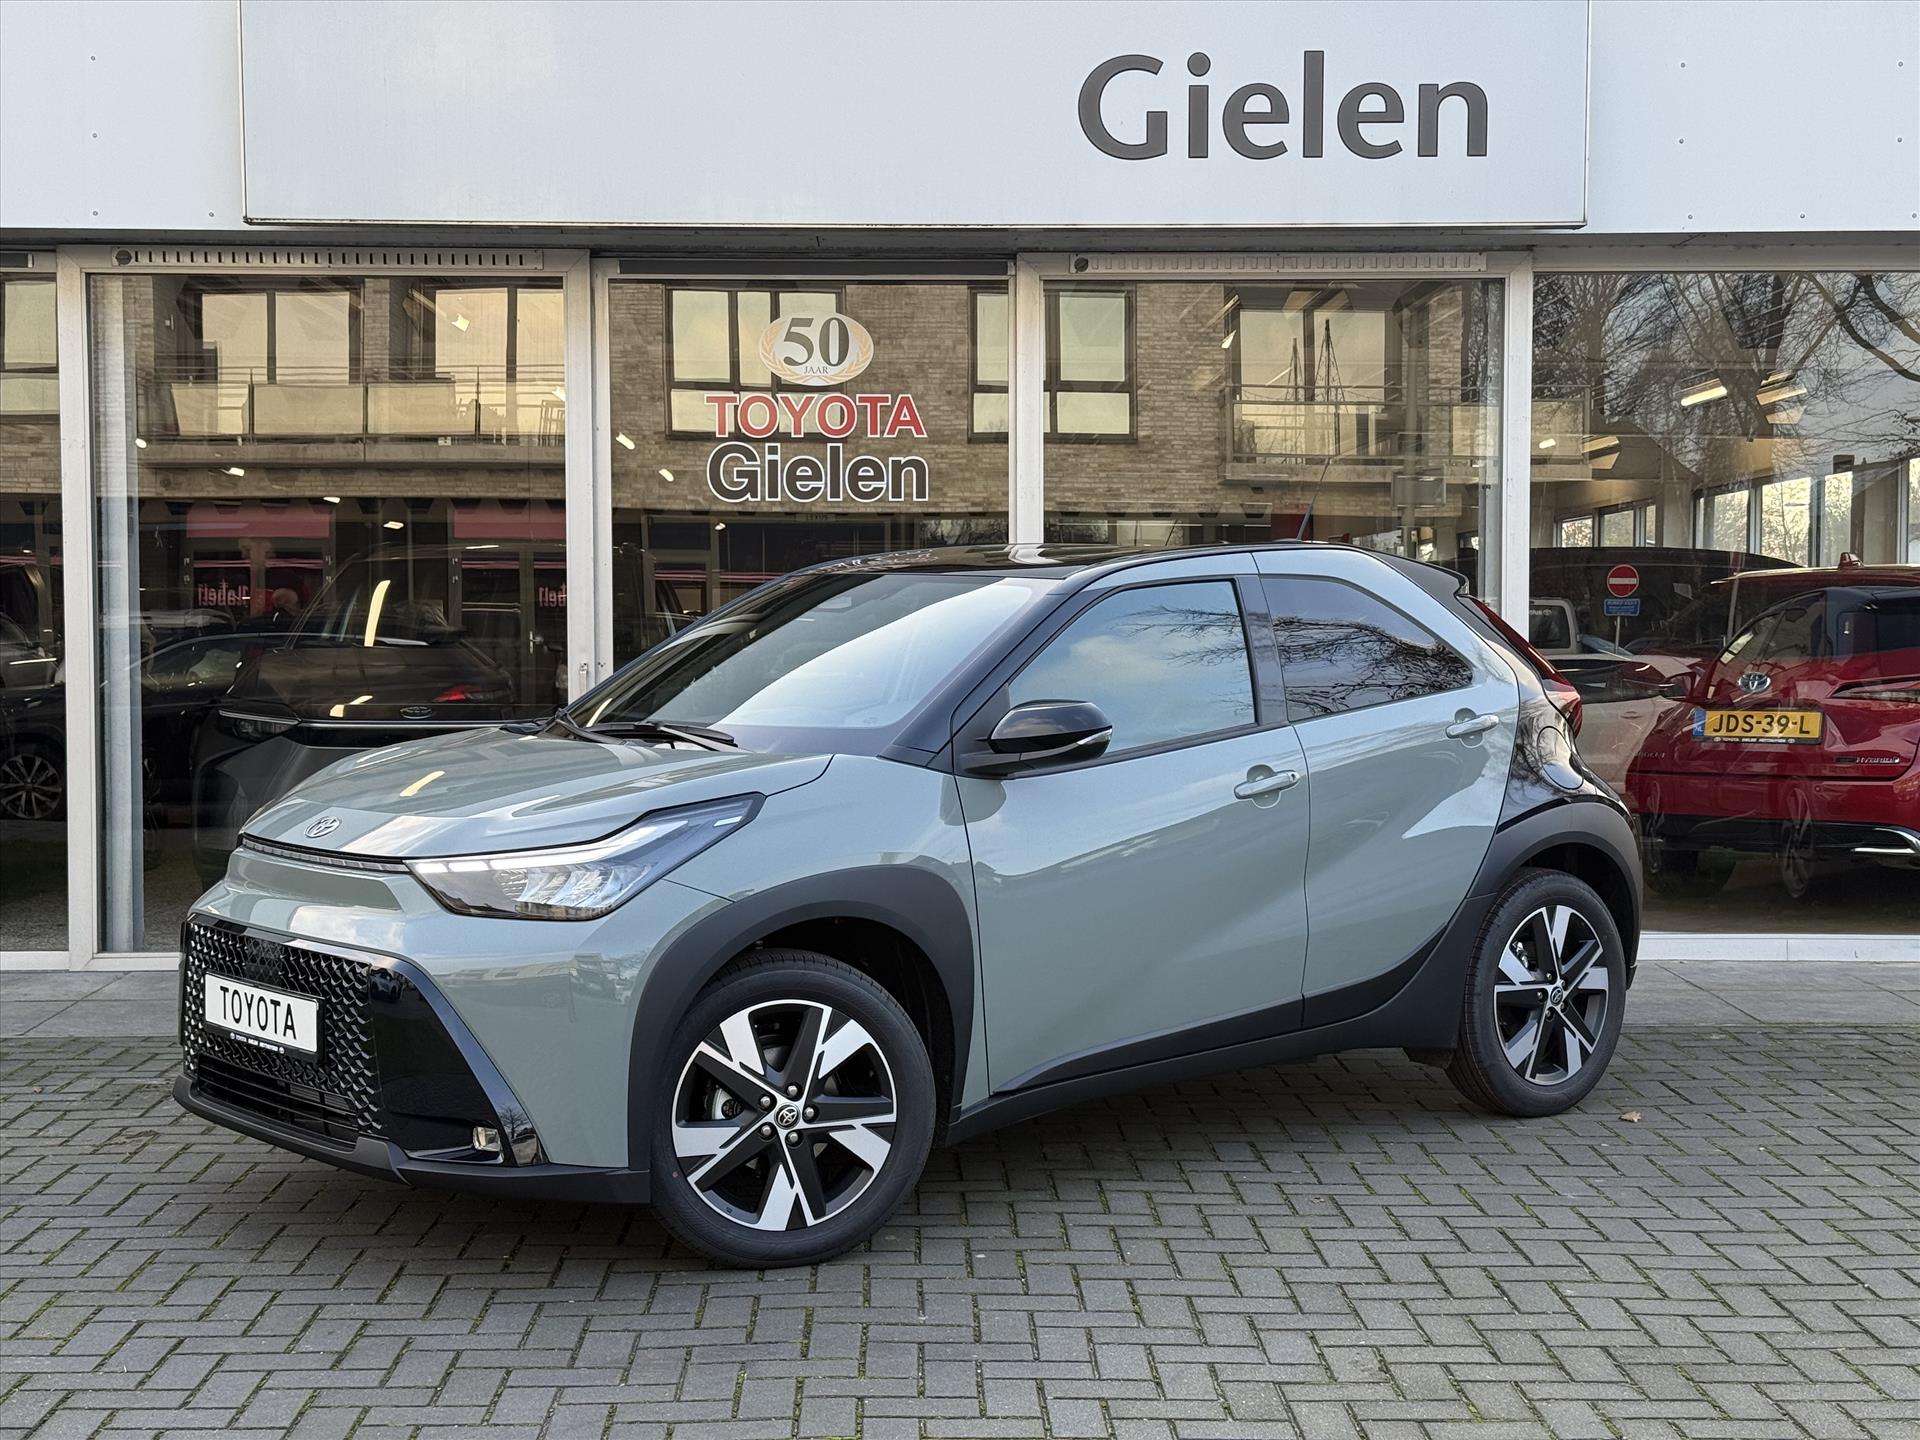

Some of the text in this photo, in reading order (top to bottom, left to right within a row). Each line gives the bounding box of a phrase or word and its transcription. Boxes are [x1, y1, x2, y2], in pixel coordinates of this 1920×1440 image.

[1078, 50, 1488, 161] Gielen
[783, 317, 850, 367] 50
[804, 365, 829, 374] JAAR
[704, 393, 928, 438] TOYOTA
[706, 441, 929, 503] Gielen
[1713, 714, 1810, 734] JDS-39-L
[220, 986, 297, 1040] TOYOTA
